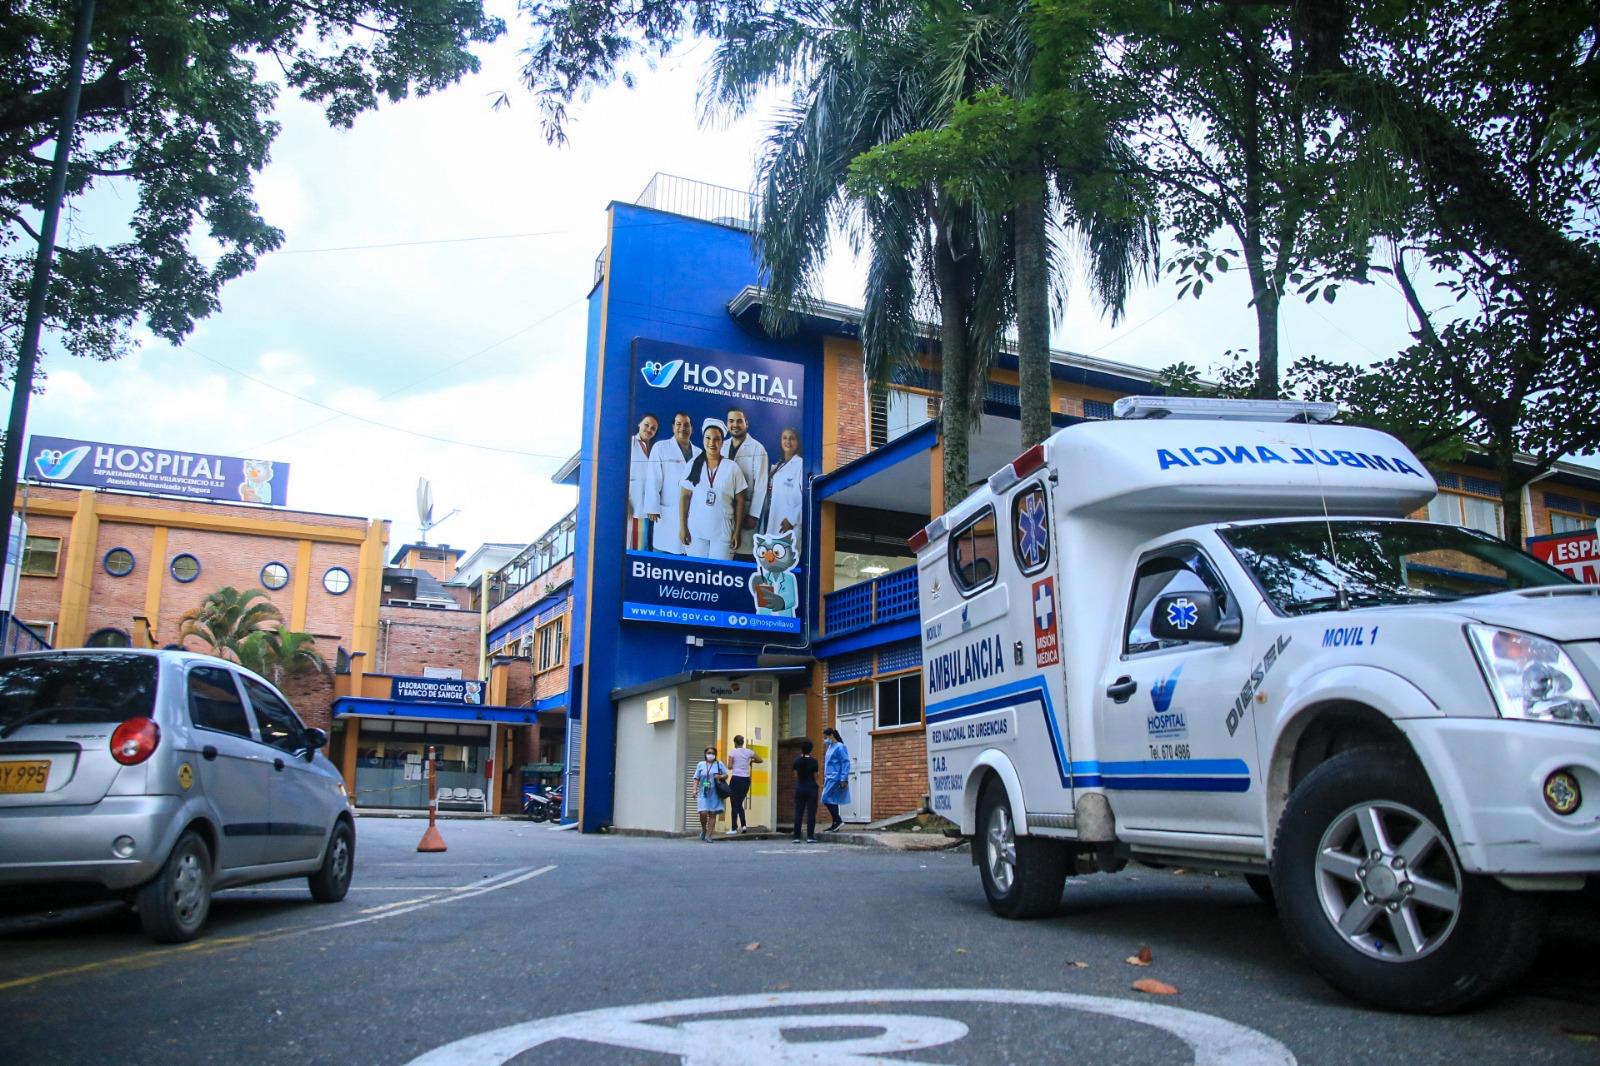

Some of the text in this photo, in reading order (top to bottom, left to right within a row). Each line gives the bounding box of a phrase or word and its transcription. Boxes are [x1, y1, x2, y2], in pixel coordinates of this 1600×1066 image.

[684, 362, 798, 400] HOSPITAL
[683, 384, 731, 397] DEPARTAMENTAL
[741, 393, 784, 405] VILLAVICENCIO
[94, 446, 226, 480] HOSPITAL
[93, 469, 148, 480] DEPARTAMENTAL
[159, 476, 210, 486] VILLAVICENCIO
[106, 477, 138, 487] Atención
[139, 480, 181, 491] Humanizada
[187, 485, 211, 494] Segura
[1557, 539, 1600, 561] ESPA
[632, 561, 744, 588] Bienvenidos
[659, 584, 720, 602] Welcome
[631, 606, 716, 622] www.hdv.gov.co
[1036, 632, 1056, 649] MISIÓN
[1321, 625, 1379, 648] MOVIL 1
[929, 634, 1004, 694] AMBULANCIA
[1037, 649, 1058, 665] MÉDICA
[398, 681, 464, 692] LABORATORIO CLÍNICO
[398, 688, 463, 699] Y BANCO DE SANGRE
[711, 686, 733, 695] Cajero
[1225, 634, 1292, 737] DIESEL
[1147, 713, 1186, 730] HOSPITAL
[932, 718, 1008, 744] RED NACIONAL DE URGENCIAS
[1161, 744, 1173, 760] 670
[16, 766, 45, 784] 995
